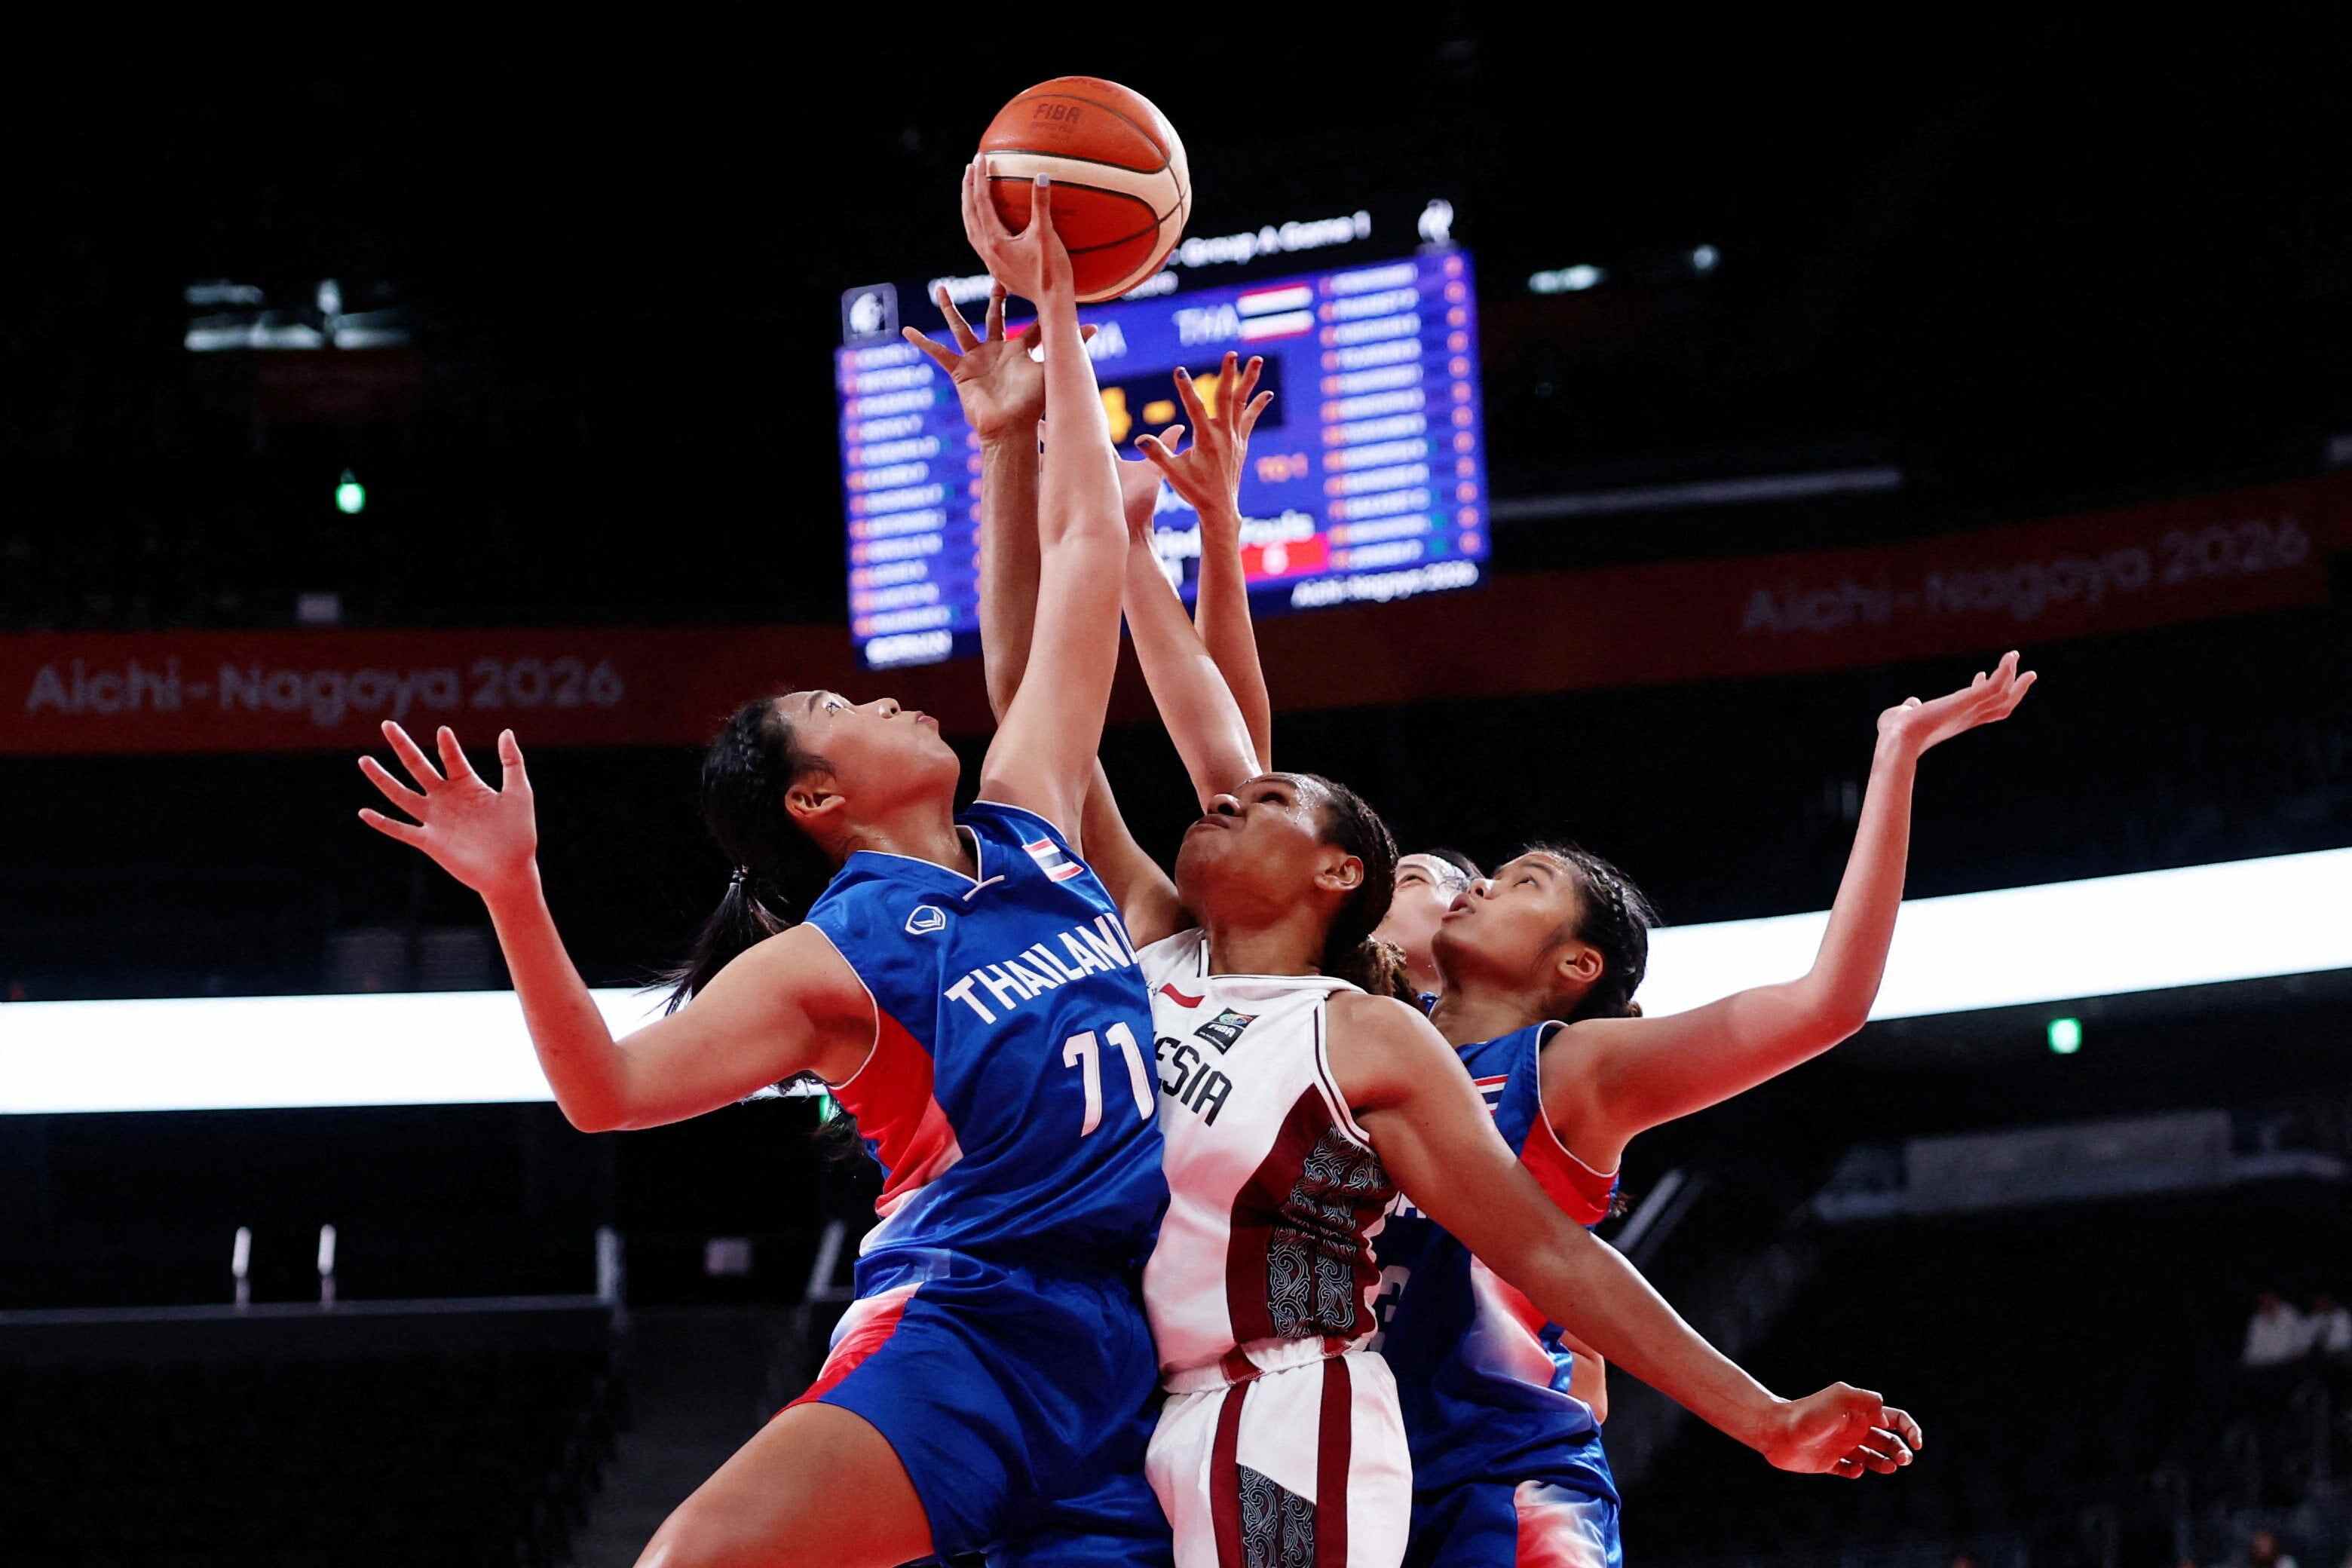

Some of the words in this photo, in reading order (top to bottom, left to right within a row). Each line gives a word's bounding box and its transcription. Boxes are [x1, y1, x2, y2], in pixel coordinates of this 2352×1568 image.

[1033, 103, 1080, 122] FIBA
[2160, 517, 2312, 585] 2026
[469, 656, 625, 710] 2026
[1208, 1022, 1236, 1037] FIBA
[1062, 1021, 1155, 1138] 71
[1153, 1034, 1233, 1127] ESIA
